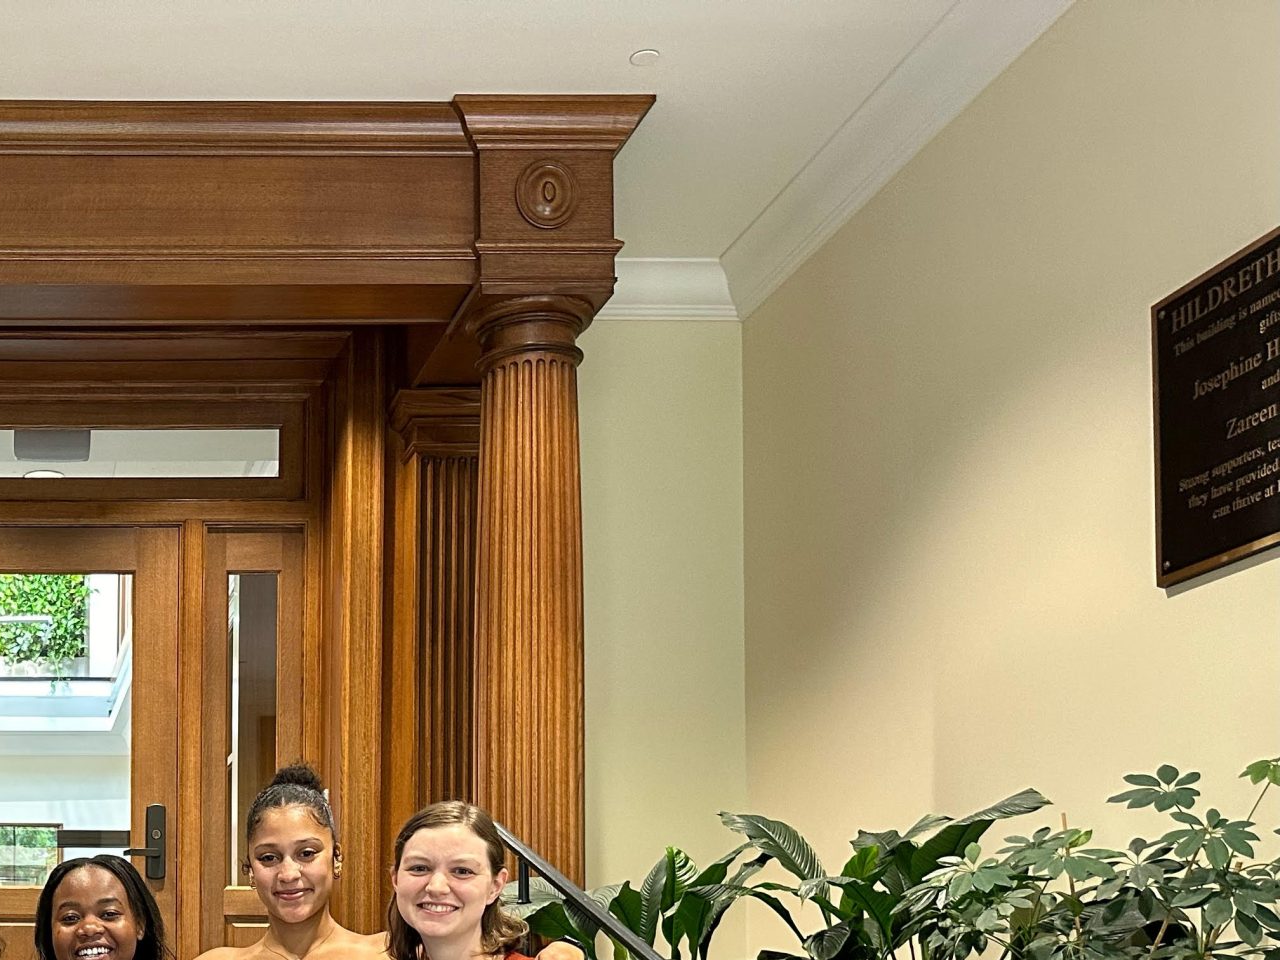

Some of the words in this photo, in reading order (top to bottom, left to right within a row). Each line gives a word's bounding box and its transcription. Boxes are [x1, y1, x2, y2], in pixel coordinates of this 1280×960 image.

[1173, 336, 1195, 357] This
[1196, 314, 1236, 344] building
[1238, 306, 1248, 321] is
[1192, 352, 1262, 400] Josephine
[1261, 367, 1280, 390] and
[1225, 403, 1278, 440] Zareen
[1179, 470, 1210, 492] Strong
[1188, 492, 1209, 509] they
[1211, 481, 1234, 499] have
[1212, 504, 1231, 519] can
[1232, 491, 1263, 512] thrive
[1264, 484, 1275, 498] at
